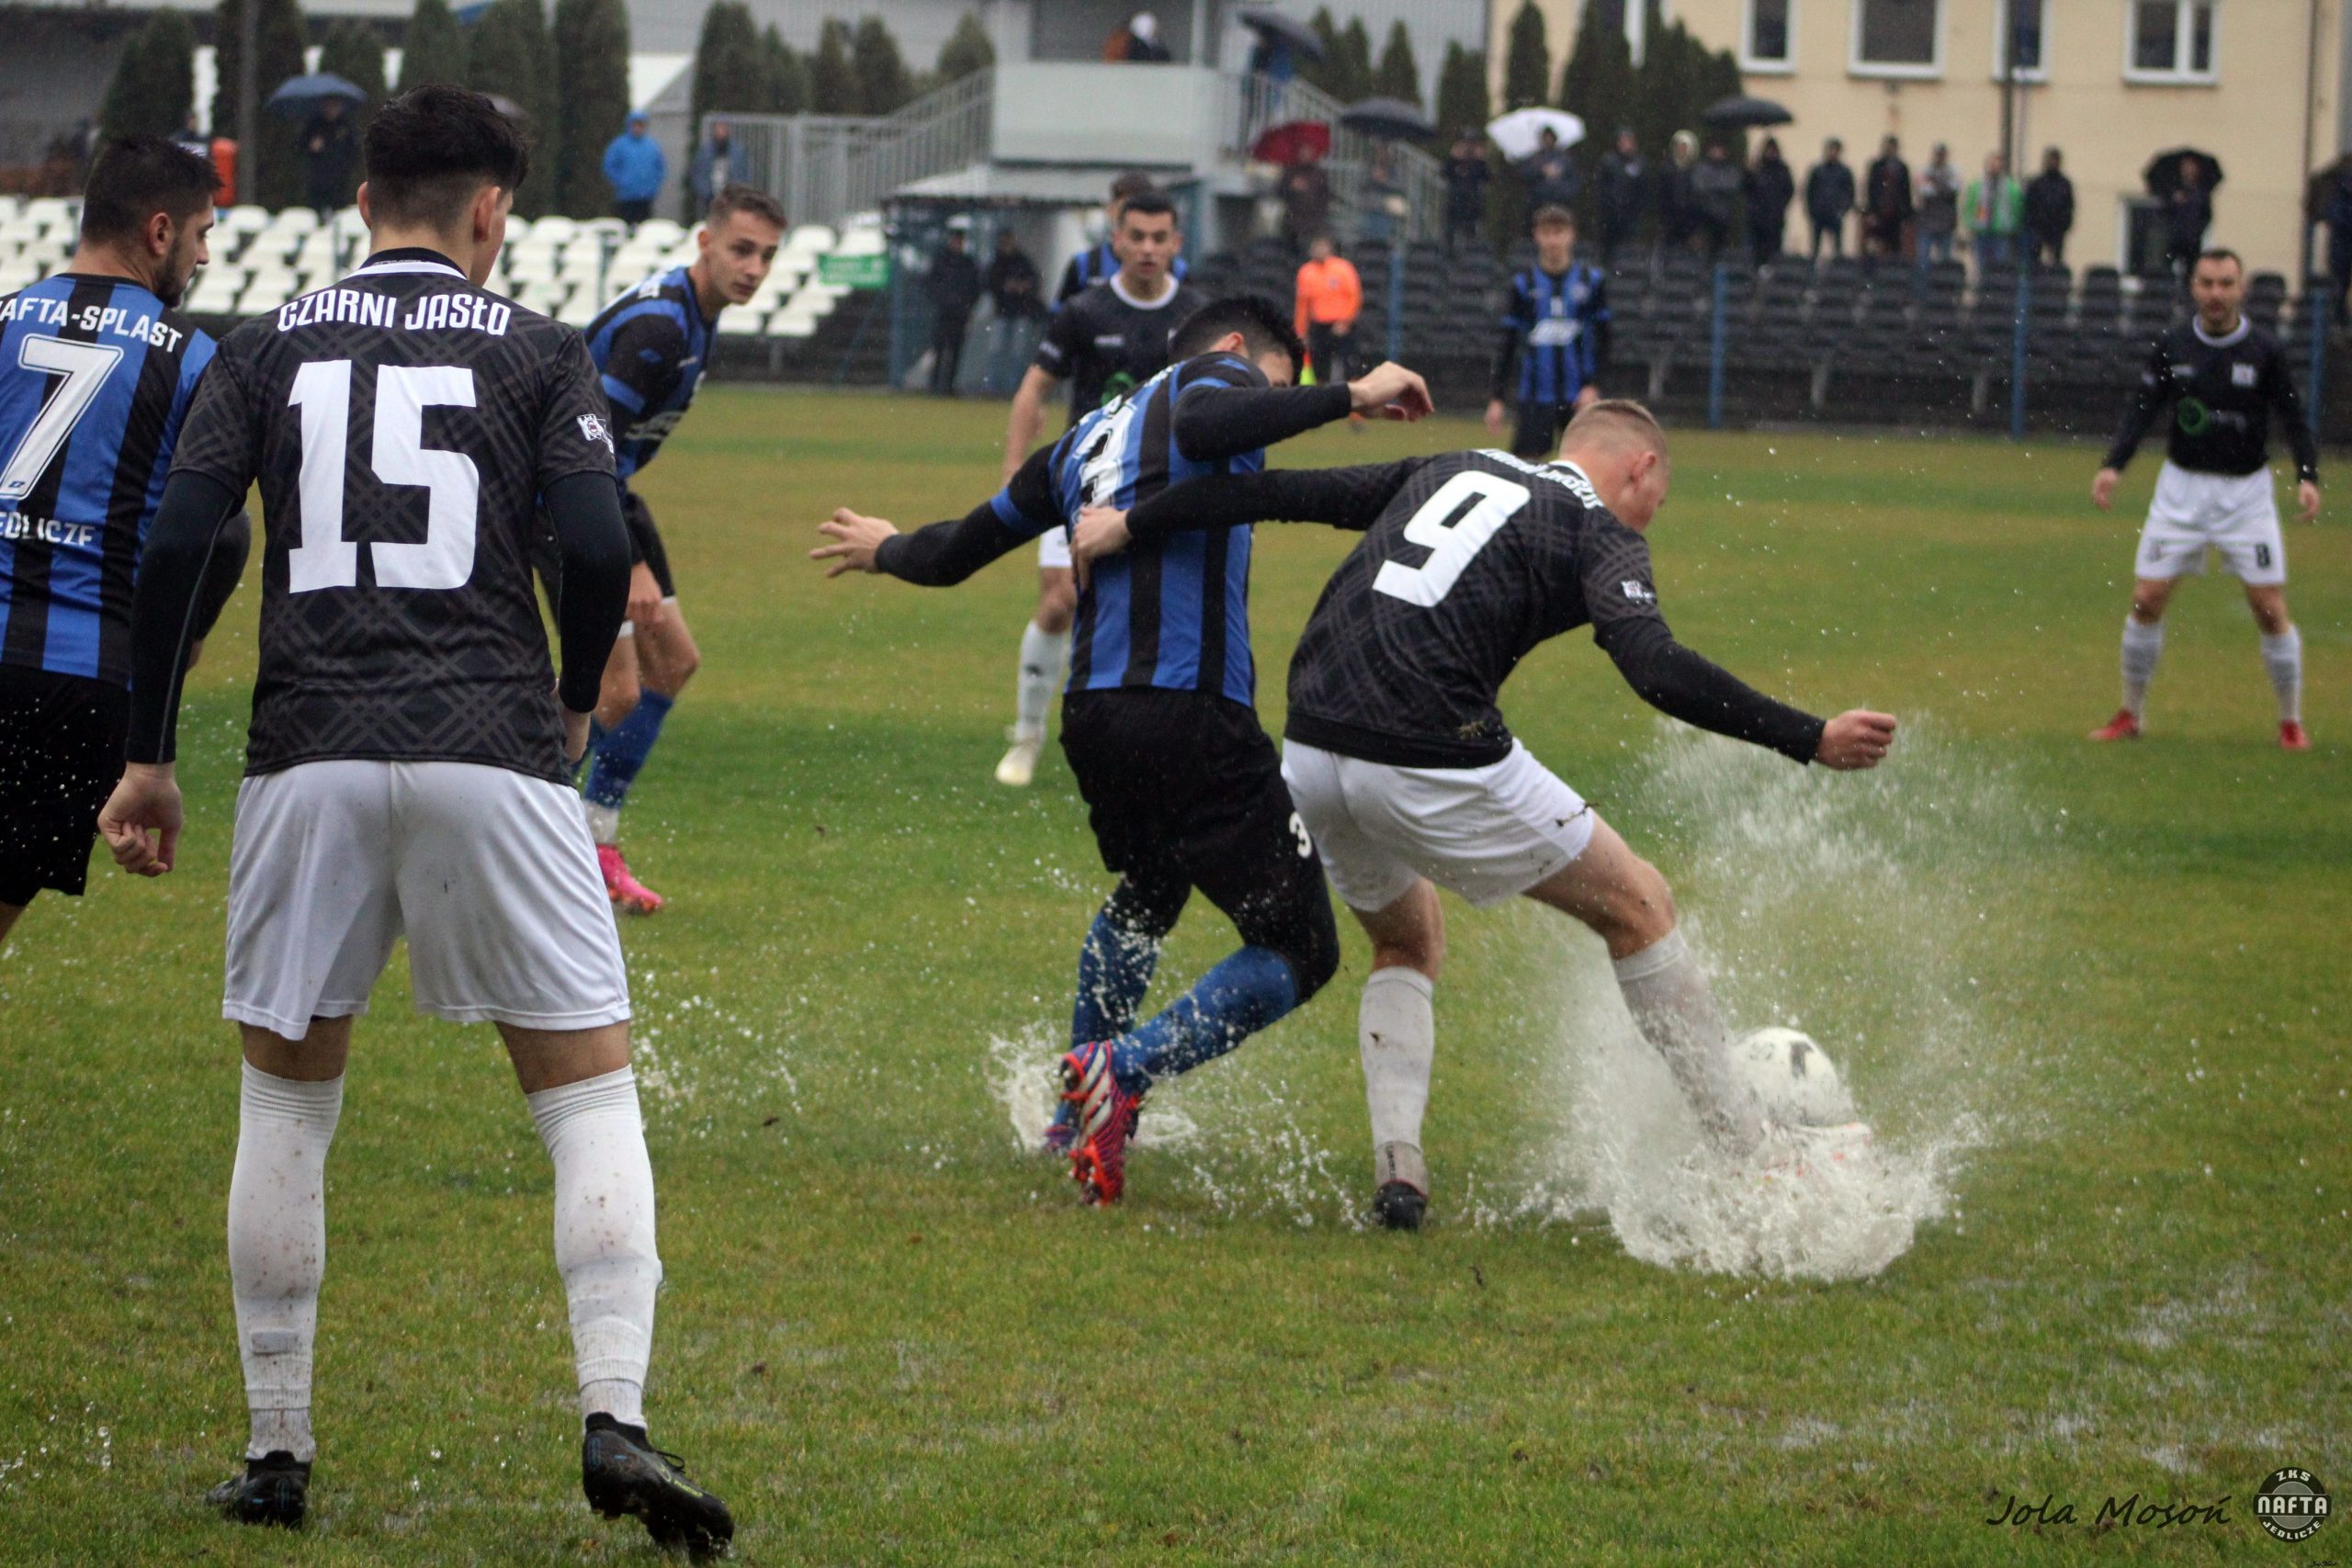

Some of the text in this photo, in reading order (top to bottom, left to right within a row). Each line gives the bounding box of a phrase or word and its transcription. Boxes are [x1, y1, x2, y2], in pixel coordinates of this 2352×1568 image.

[277, 288, 398, 333] CZARNI
[0, 333, 125, 501] 7
[288, 359, 480, 593] 15
[1372, 470, 1532, 607] 9
[1289, 811, 1312, 858] 3
